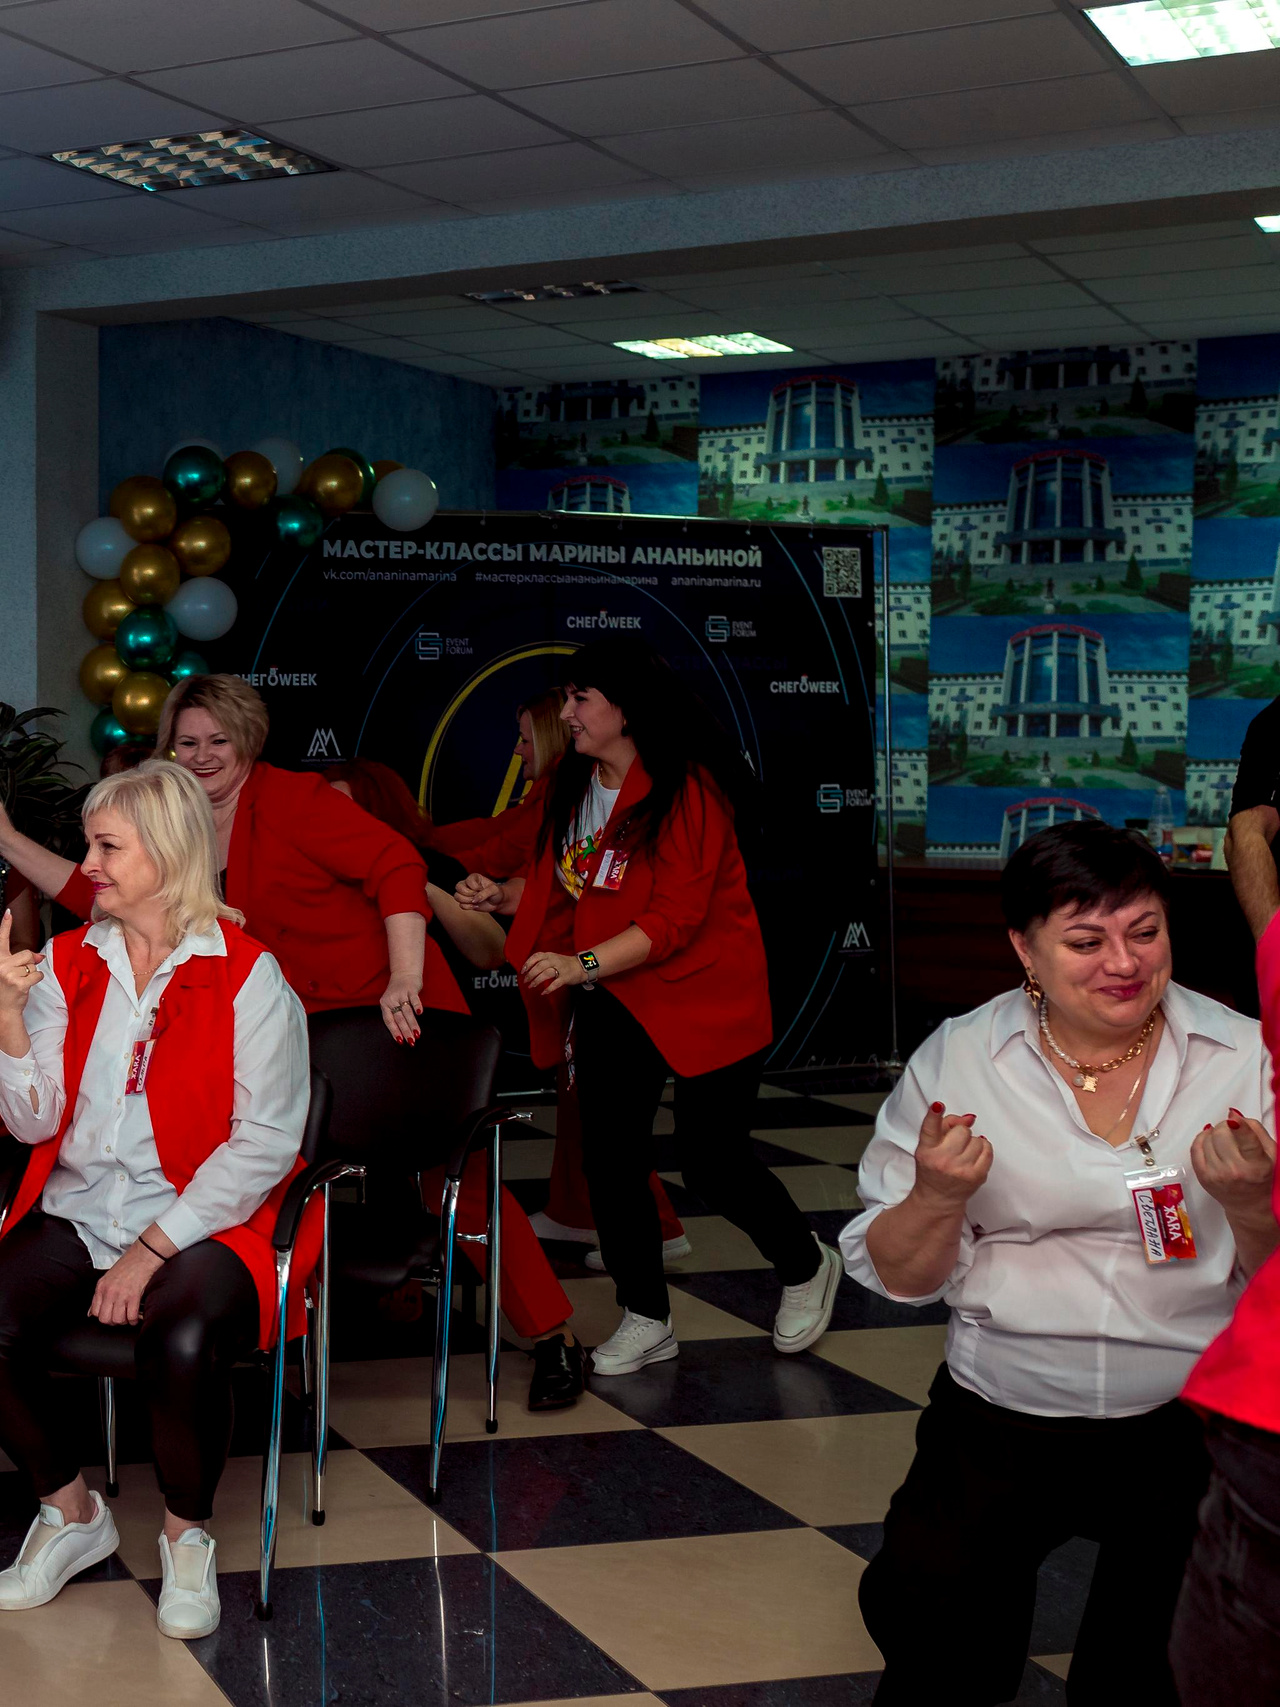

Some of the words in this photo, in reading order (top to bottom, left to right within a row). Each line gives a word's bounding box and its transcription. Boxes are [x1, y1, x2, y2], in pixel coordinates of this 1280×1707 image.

[322, 539, 523, 562] МАСТЕР-КЛАССЫ
[528, 543, 627, 564] МАРИНЫ
[631, 545, 763, 568] АНАНЬИНОЙ
[323, 568, 457, 582] vk.com/ananinamarina
[671, 575, 762, 588] ananinamarina.ru
[445, 637, 470, 646] EVENT
[445, 646, 474, 655] FORUM
[845, 788, 869, 798] EVENT
[845, 798, 873, 807] FORUM
